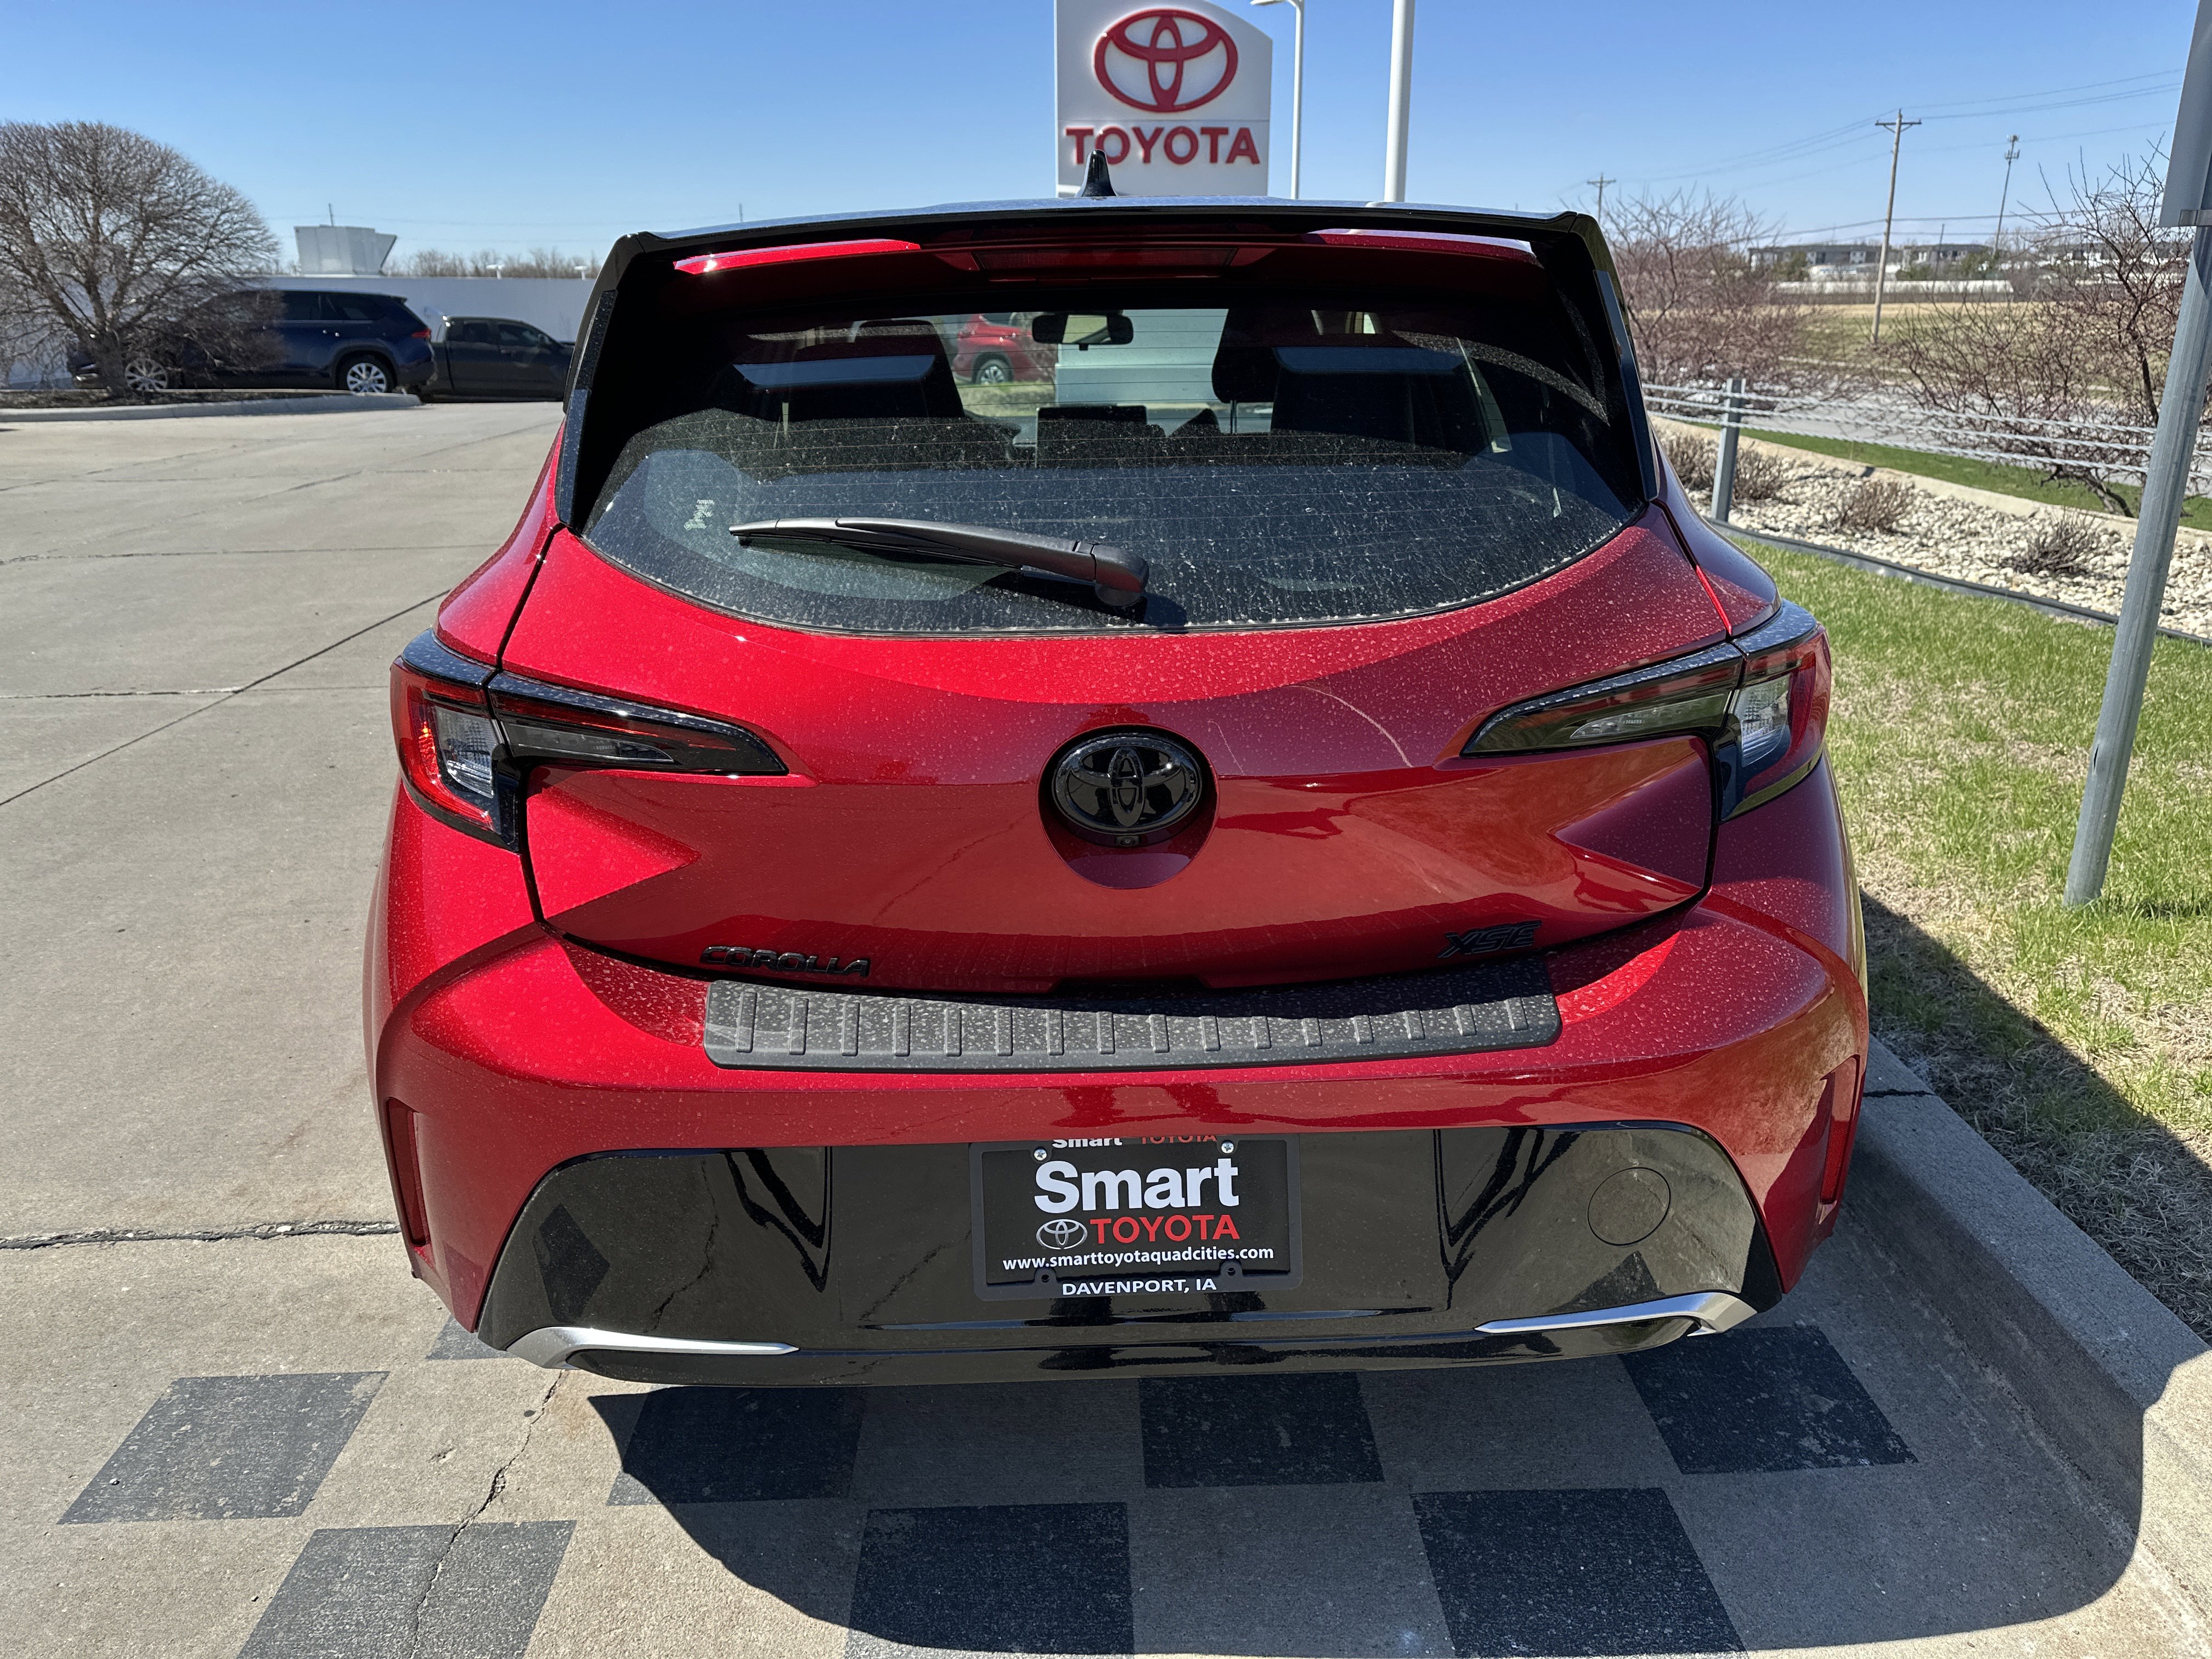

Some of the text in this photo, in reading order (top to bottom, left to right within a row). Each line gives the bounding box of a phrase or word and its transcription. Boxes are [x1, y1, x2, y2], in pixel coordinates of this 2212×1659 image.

[1065, 126, 1260, 165] TOYOTA
[1436, 919, 1543, 958] XSE
[699, 945, 871, 978] COROLLA
[1034, 1158, 1239, 1214] Smart
[1090, 1214, 1240, 1245] TOYOTA
[1002, 1246, 1274, 1271] www.smarttoyotaquadcities.com
[1062, 1278, 1217, 1296] DAVENPORT, IA
